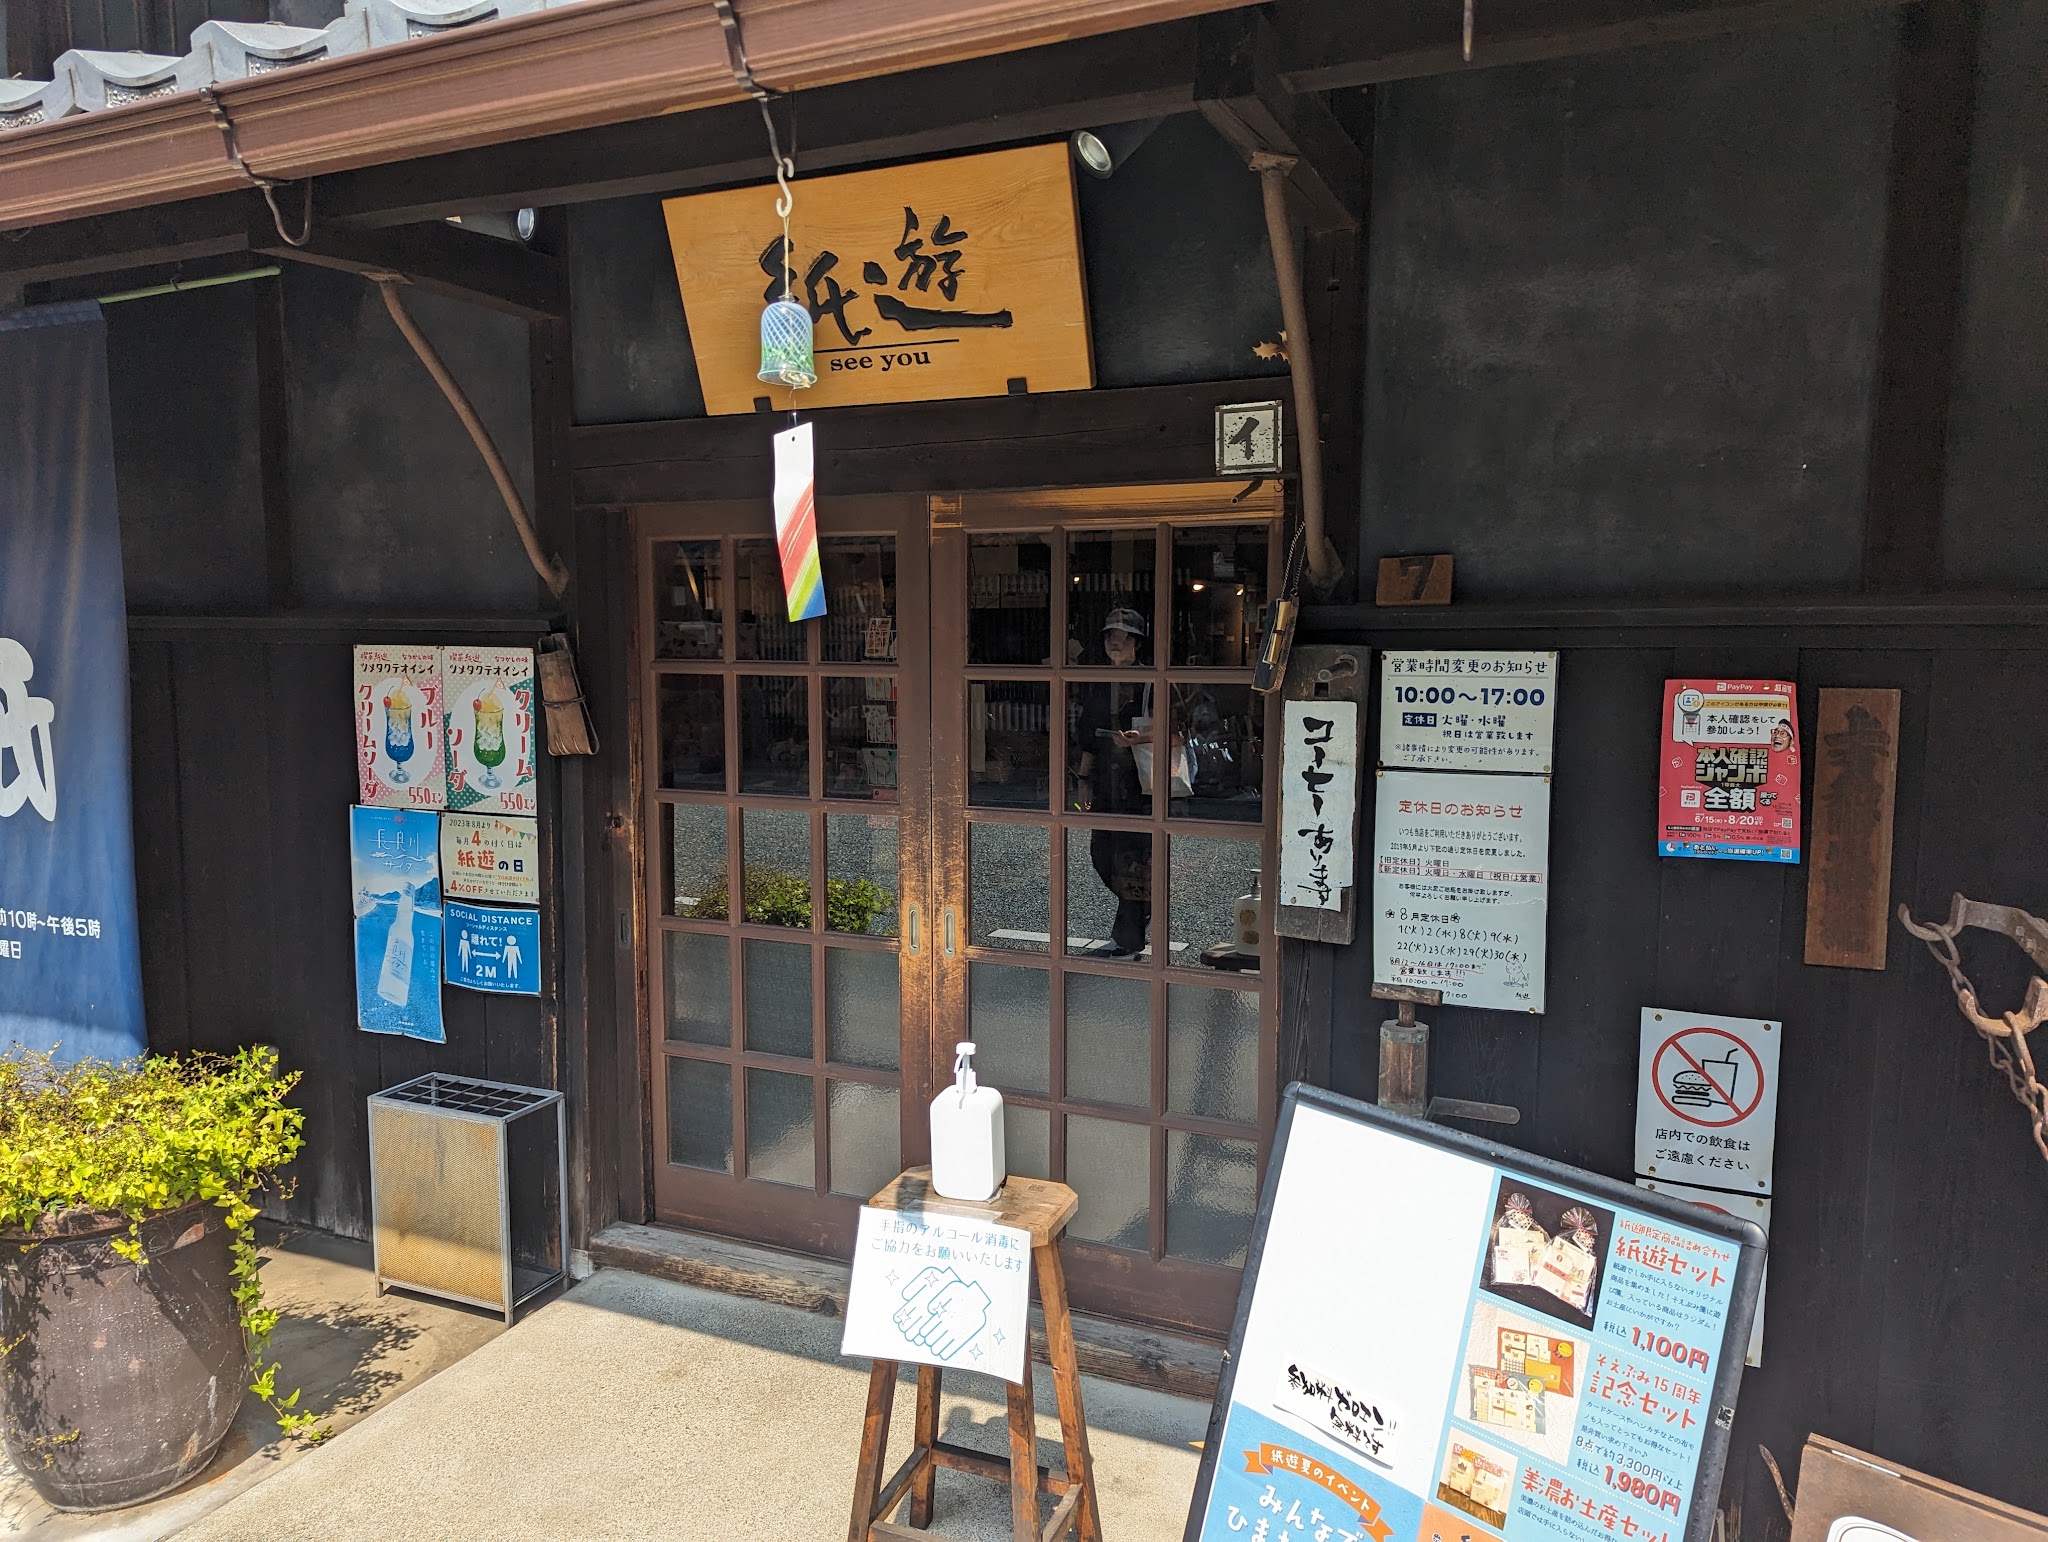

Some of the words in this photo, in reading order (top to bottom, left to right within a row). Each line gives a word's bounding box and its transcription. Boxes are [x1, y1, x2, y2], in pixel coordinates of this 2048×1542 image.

[830, 353, 873, 372] see
[880, 350, 932, 374] you
[1227, 416, 1260, 461] イ
[361, 663, 434, 675] ツメタクテオイシイ
[450, 665, 529, 677] ツメタクテオイシイ
[1391, 658, 1548, 674] 営業時間変更のお知らせ
[1727, 683, 1754, 691] PayPay
[420, 685, 439, 750] ブルー
[1404, 714, 1436, 726] 定休日
[1442, 714, 1506, 727] 火曜・水曜
[1706, 714, 1776, 724] 本人確認をして
[359, 684, 380, 799] クリームソーダ
[515, 690, 533, 777] クリーム
[1442, 729, 1534, 741] 祝日は営業致します
[447, 728, 467, 792] ソーダ
[1403, 754, 1453, 764] ご了承下さい。
[1696, 747, 1769, 765] 本人確認
[1695, 763, 1768, 783] ジャンボ
[408, 786, 444, 805] 550エン
[500, 792, 536, 810] 550エン
[1704, 787, 1757, 811] 全額
[1398, 800, 1523, 818] 定休日のお知らせ
[1728, 815, 1755, 826] 8/20
[449, 819, 491, 829] 2023年8月より
[1399, 827, 1523, 843] いつも当店をご利用いただきありがとうございます。
[368, 829, 420, 857] 長良川
[457, 849, 523, 872] 紙遊の日
[450, 908, 479, 922] SOCIAL
[481, 914, 533, 926] DISTANCE
[475, 964, 497, 979] 2M
[1655, 1128, 1751, 1151] 店内での飲食は
[880, 1219, 1020, 1251] 手指のアルコール消毒に
[871, 1237, 1023, 1273] ご協力をお願いいたします
[1615, 1236, 1726, 1287] 紙遊セット
[1613, 1262, 1723, 1305] 紙遊でしか手に入らないオリジナル
[1603, 1321, 1627, 1337] 税込
[1631, 1327, 1709, 1374] 1,100円
[1589, 1371, 1696, 1429] 記念セット
[1586, 1401, 1695, 1450] カードケースやハンカチなどの布モ
[1270, 1448, 1371, 1511] 紙遊夏のイベント
[1577, 1458, 1601, 1476] 税込
[1605, 1465, 1682, 1517] 1,980円
